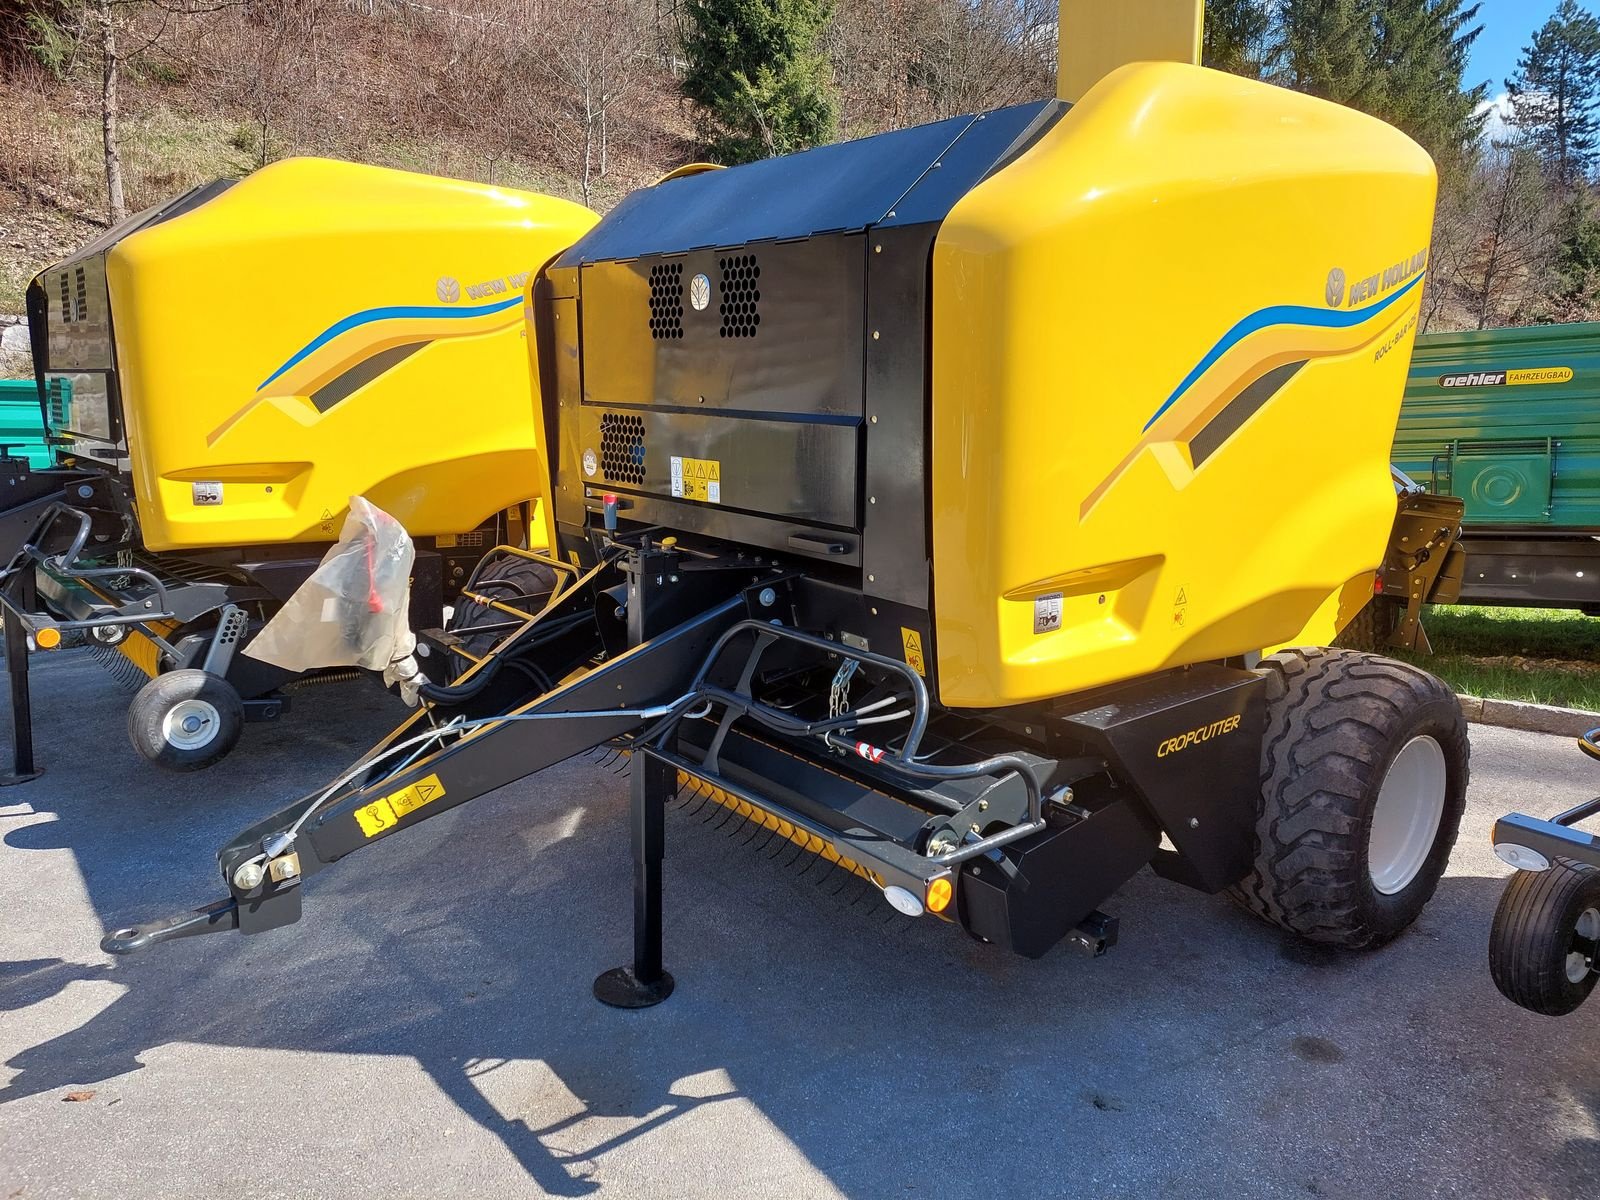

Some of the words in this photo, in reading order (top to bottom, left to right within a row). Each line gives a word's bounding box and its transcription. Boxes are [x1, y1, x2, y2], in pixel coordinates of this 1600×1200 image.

[465, 278, 507, 300] NEW
[1348, 272, 1380, 307] NEW
[1443, 373, 1504, 387] oehler
[1508, 370, 1571, 381] FAHRZEUGBAU
[1157, 714, 1241, 757] CROPCUTTER
